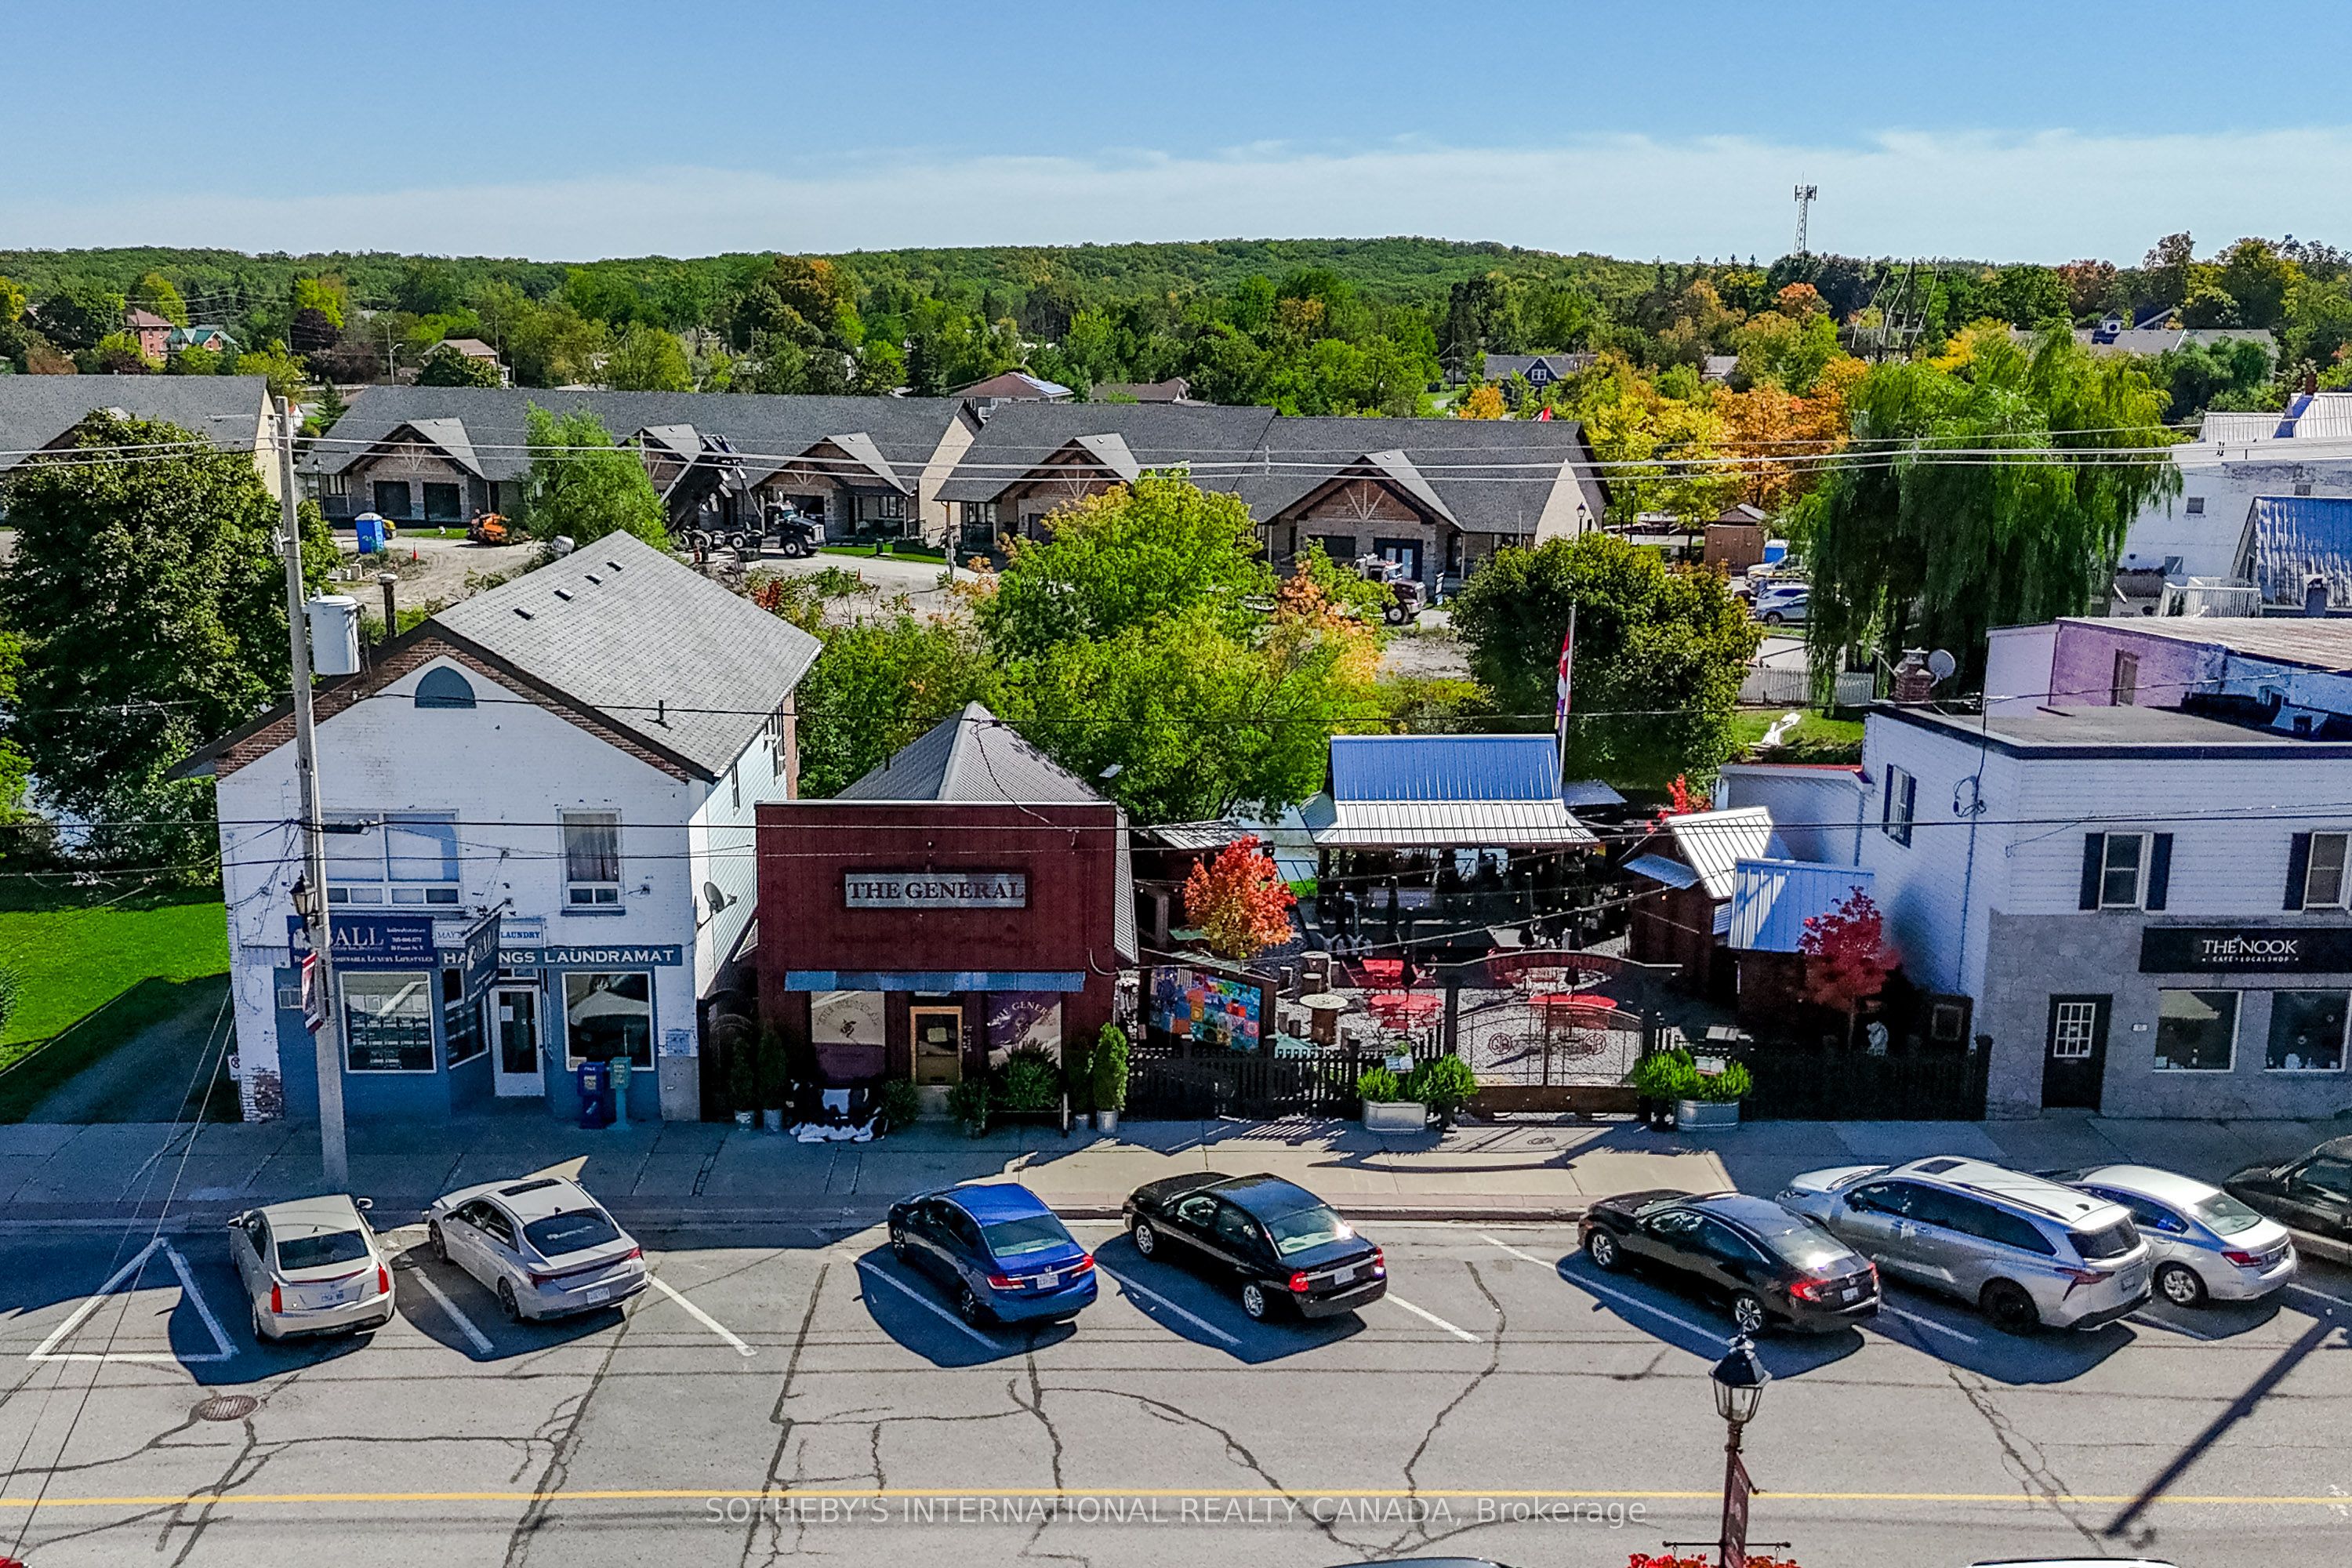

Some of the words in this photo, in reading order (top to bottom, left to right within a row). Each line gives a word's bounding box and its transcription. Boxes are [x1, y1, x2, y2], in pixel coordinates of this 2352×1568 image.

[847, 881, 901, 899] THE
[905, 881, 1025, 900] GENERAL
[330, 927, 384, 946] ALL
[500, 931, 541, 939] LAUNDRY
[443, 951, 536, 964] HANGS
[543, 949, 674, 964] LAUNDRAMAT
